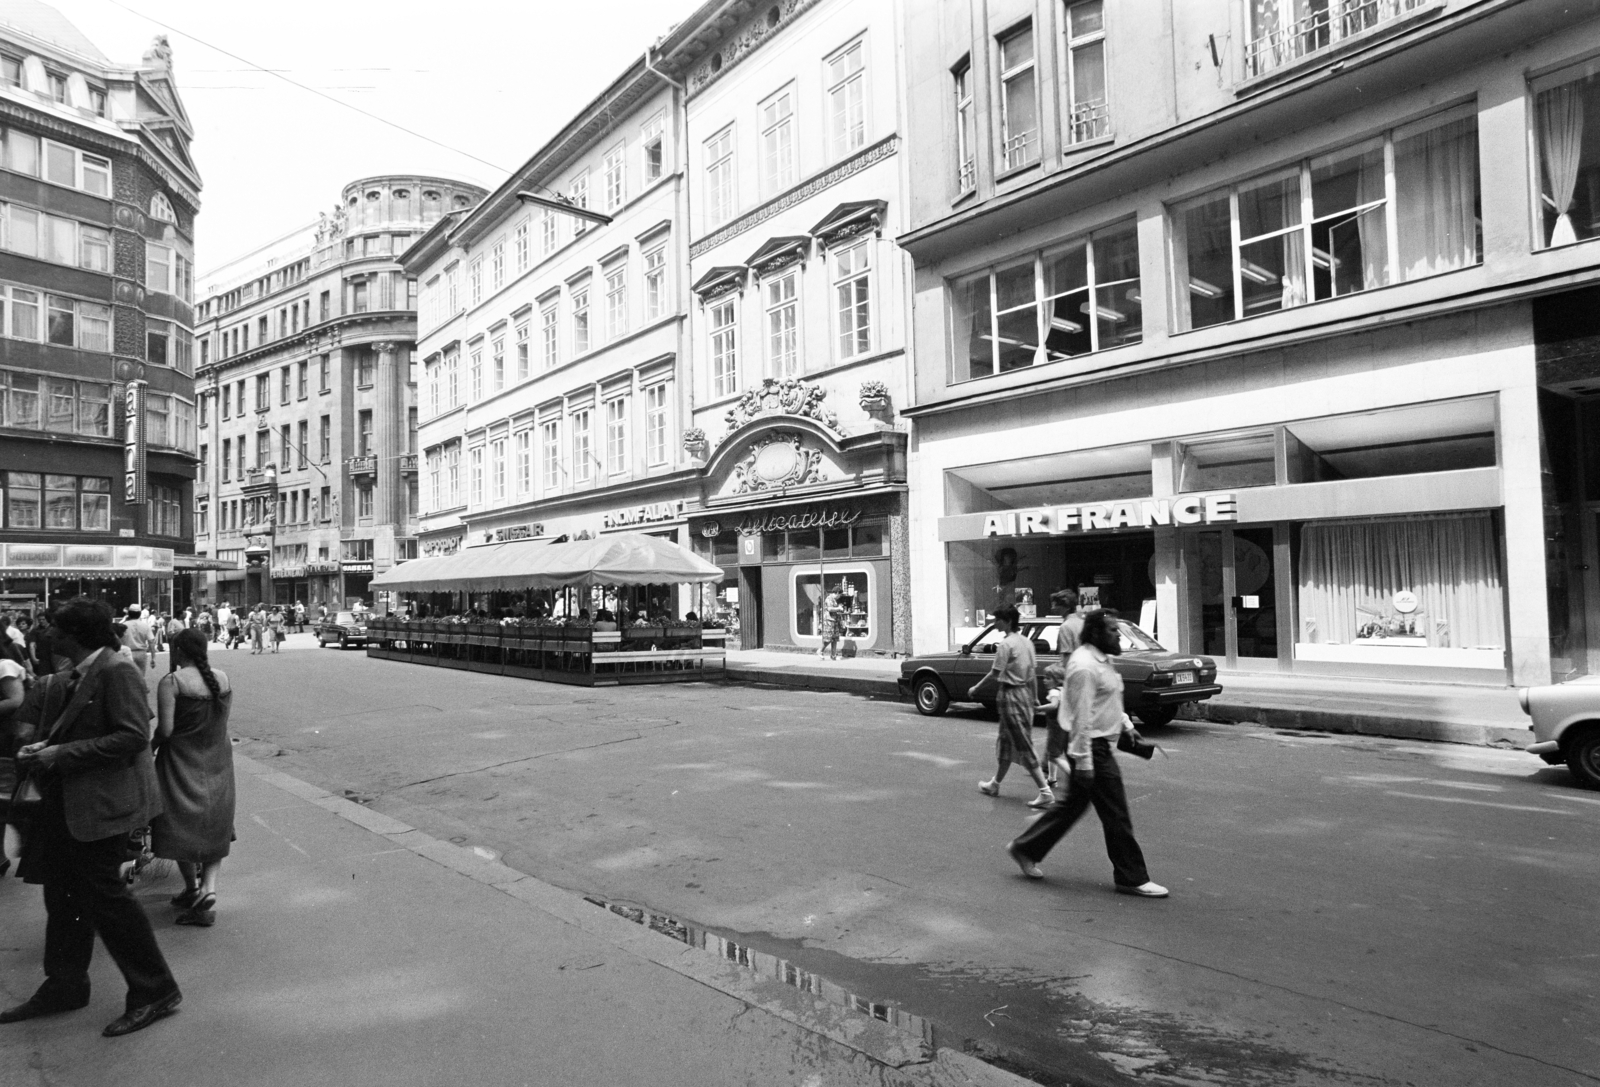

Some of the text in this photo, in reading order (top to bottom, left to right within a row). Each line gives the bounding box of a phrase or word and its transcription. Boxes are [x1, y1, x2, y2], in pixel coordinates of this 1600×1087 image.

[983, 494, 1237, 536] AIR FRANCE
[342, 564, 372, 572] SABENA
